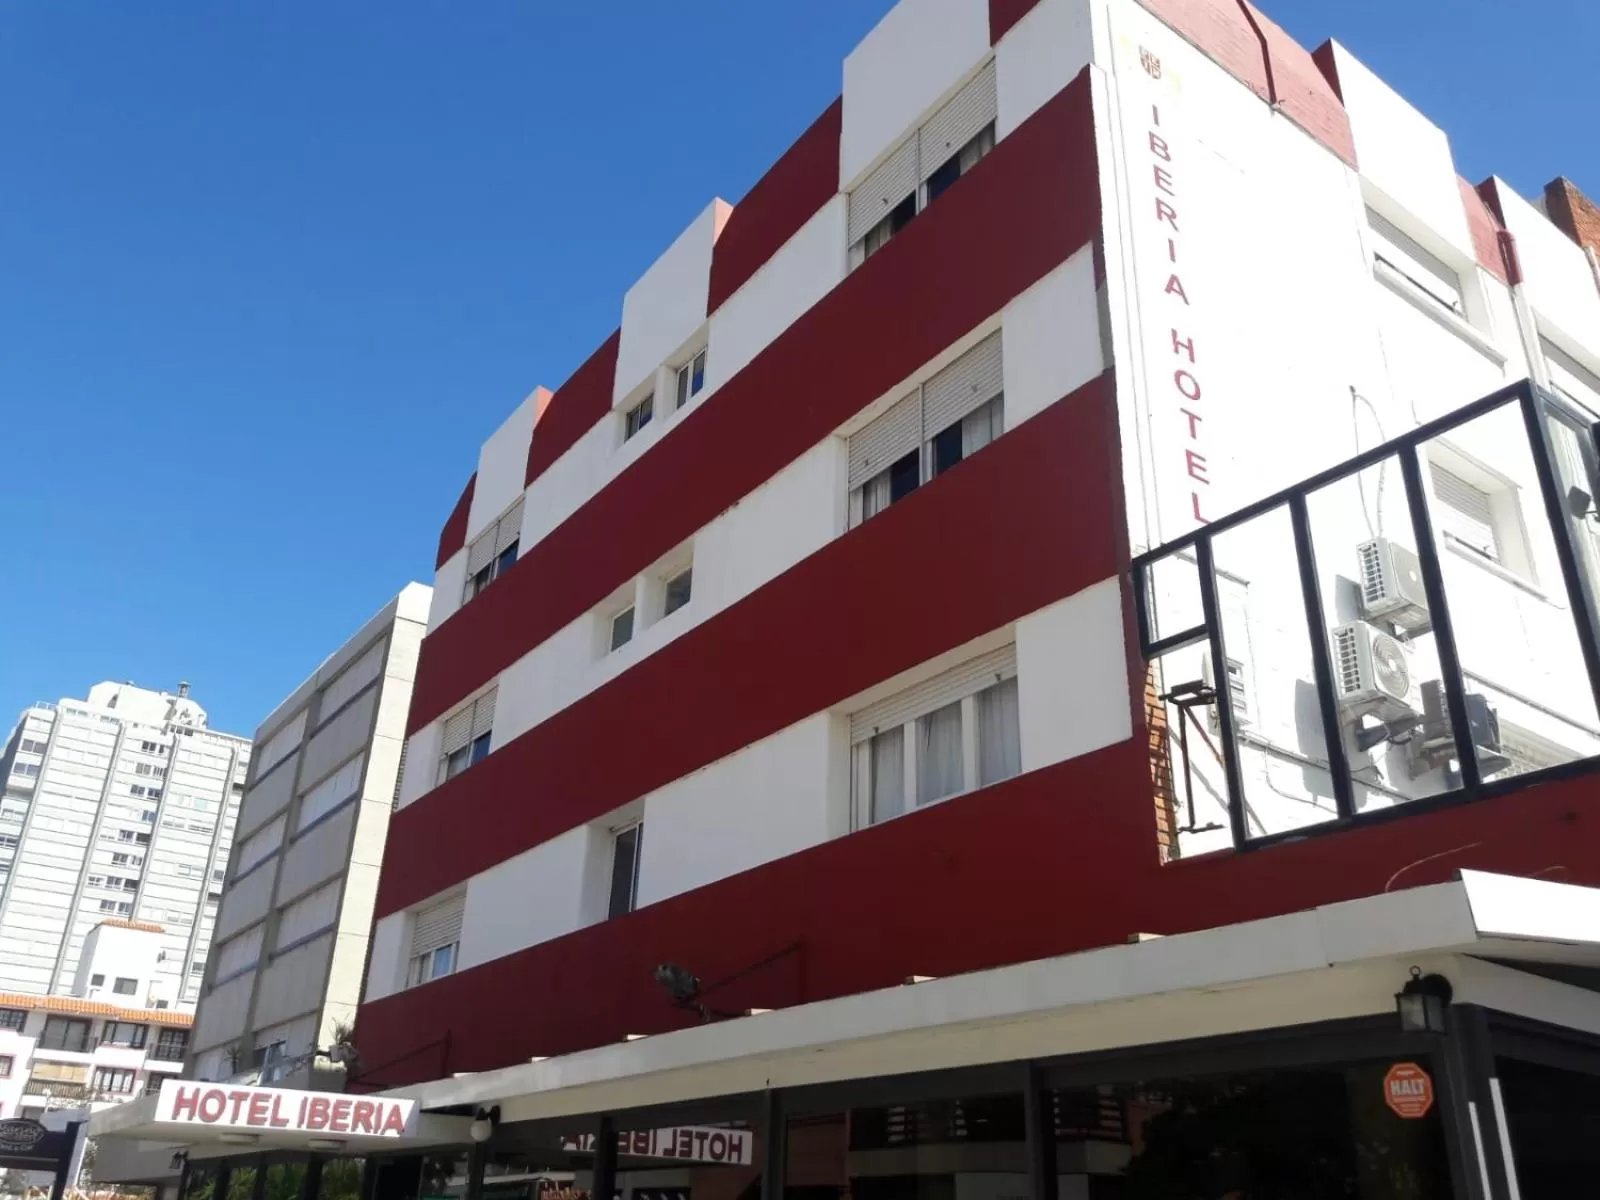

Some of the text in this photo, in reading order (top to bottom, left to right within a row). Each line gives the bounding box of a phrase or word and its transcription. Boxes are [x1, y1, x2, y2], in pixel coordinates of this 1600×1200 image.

[1148, 104, 1211, 526] IBERIA HOTEL
[172, 1086, 405, 1136] HOTEL IBERIA
[1391, 1079, 1424, 1095] HALT
